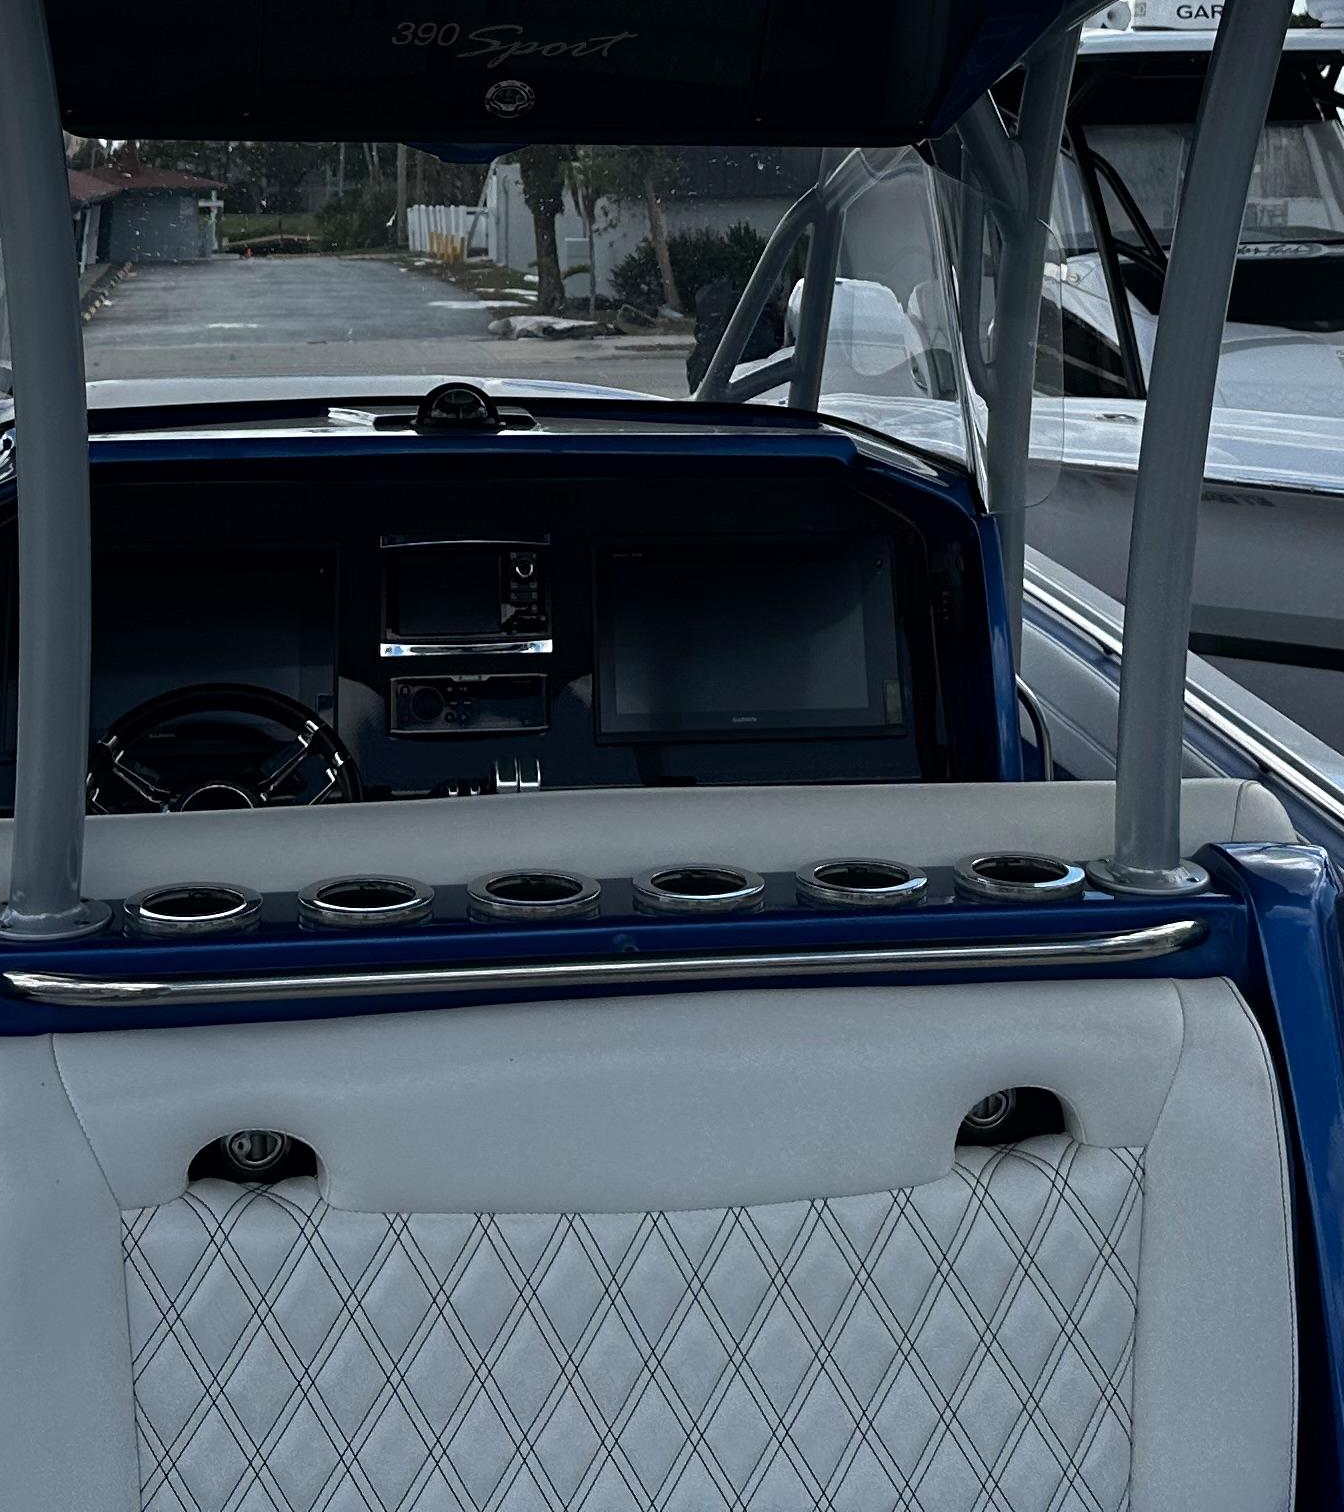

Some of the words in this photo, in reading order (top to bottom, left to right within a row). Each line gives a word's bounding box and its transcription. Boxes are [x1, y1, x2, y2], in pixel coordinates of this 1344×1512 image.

[1176, 4, 1224, 19] GAR
[392, 22, 461, 46] 390
[456, 24, 640, 69] Sport
